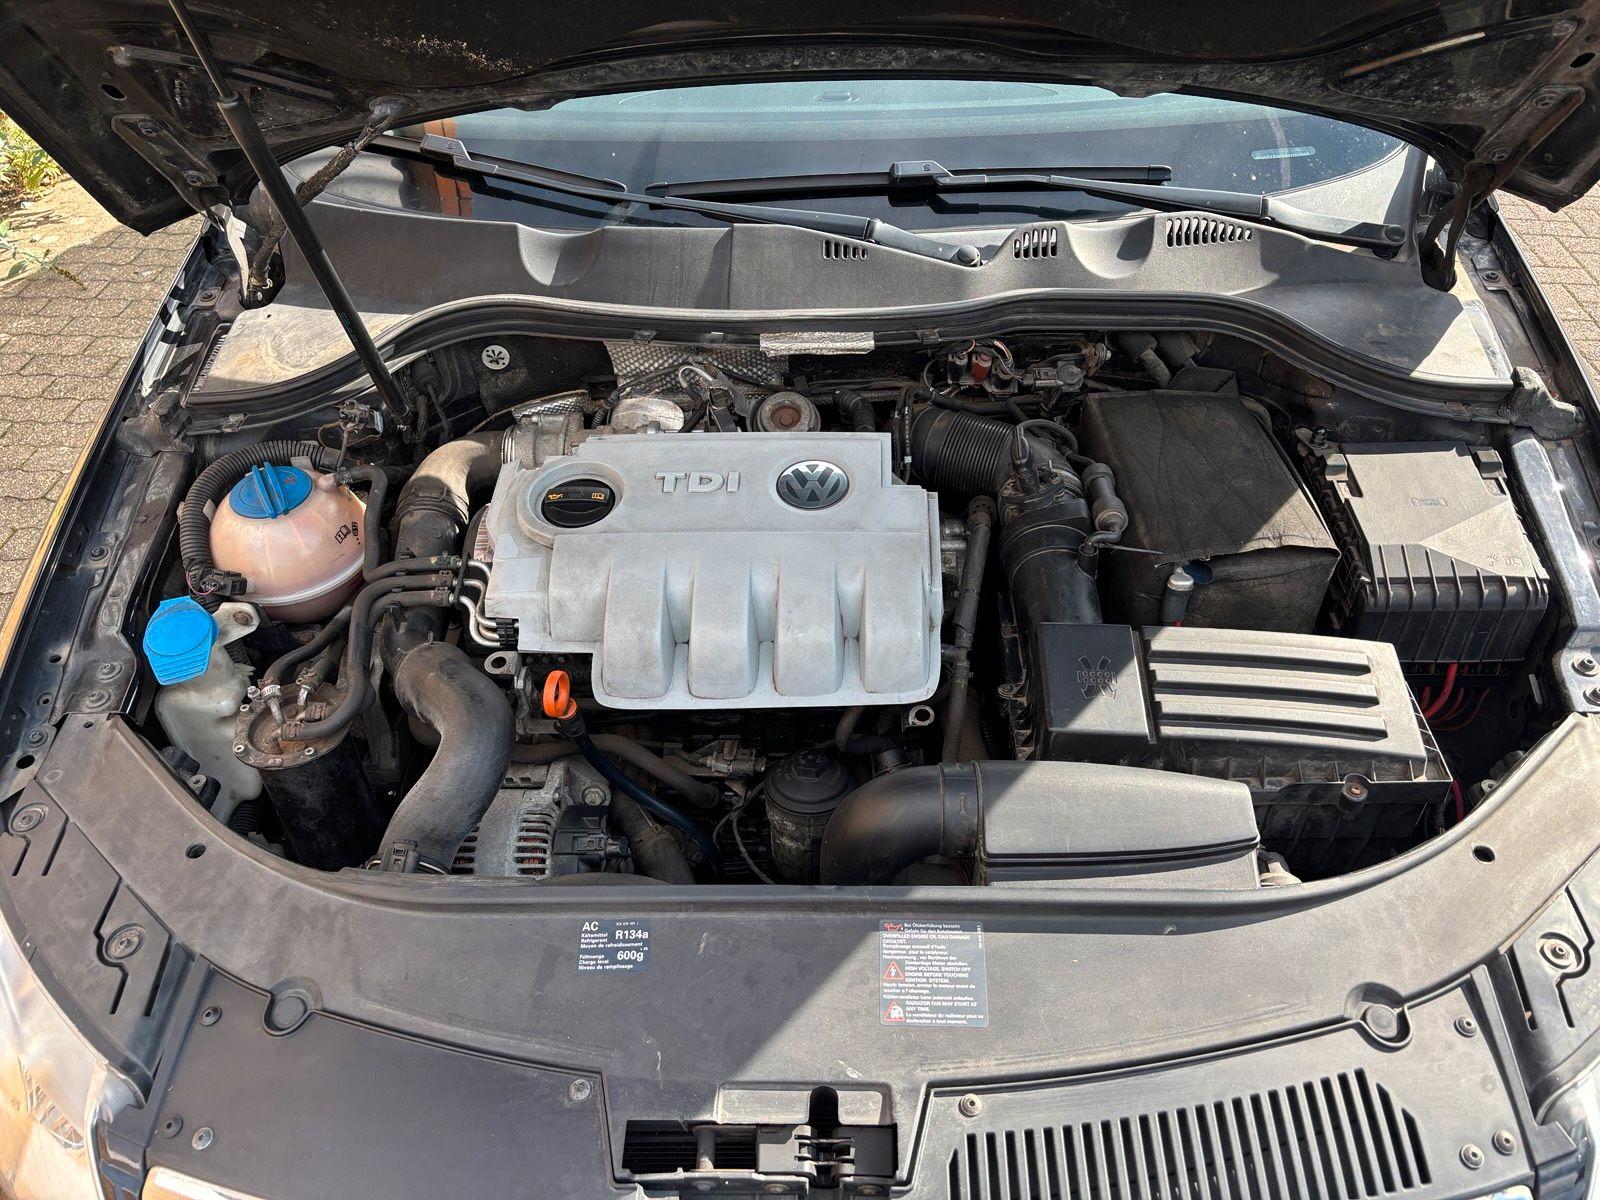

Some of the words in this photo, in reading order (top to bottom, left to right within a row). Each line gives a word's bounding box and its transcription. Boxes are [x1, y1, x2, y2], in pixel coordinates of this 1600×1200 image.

[655, 471, 741, 493] TDI
[776, 459, 850, 510] VW
[582, 921, 599, 931] AC
[615, 929, 649, 940] R134a
[616, 950, 644, 962] 600g
